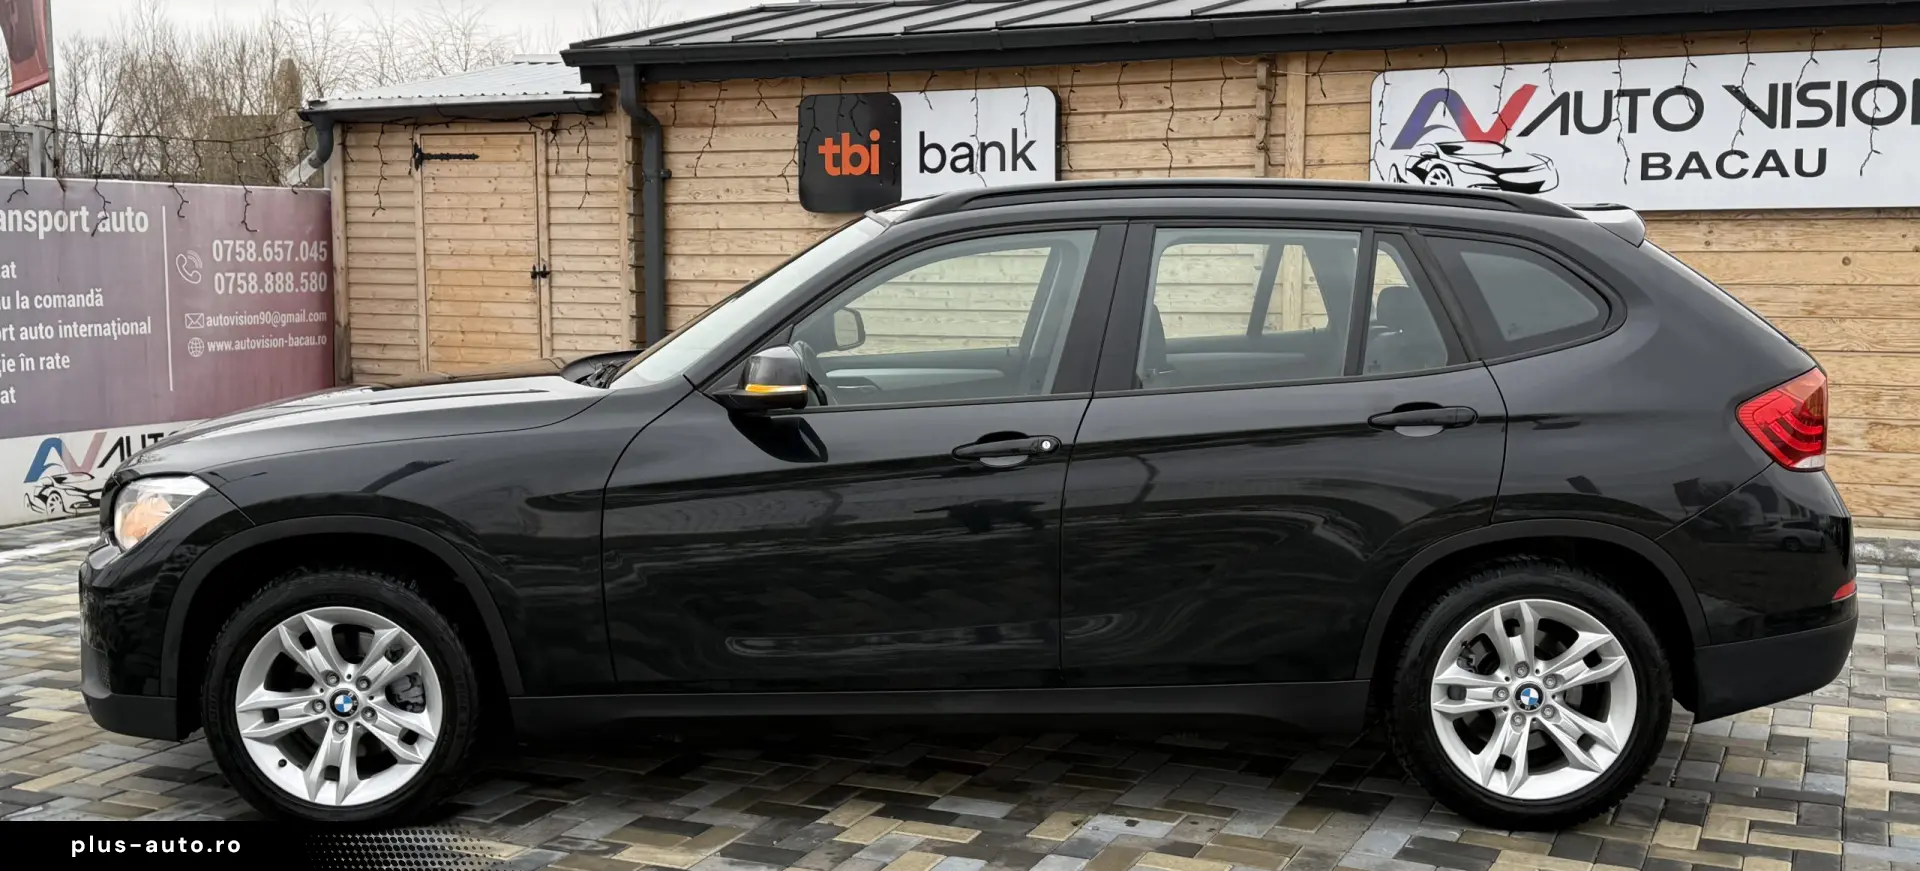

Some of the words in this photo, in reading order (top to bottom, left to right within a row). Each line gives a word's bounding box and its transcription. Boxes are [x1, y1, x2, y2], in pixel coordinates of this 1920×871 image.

[1517, 87, 1705, 137] AUTO
[1721, 78, 1920, 130] VISIO
[818, 129, 881, 177] tbi
[918, 127, 1037, 174] bank
[1640, 148, 1828, 181] BACAU
[97, 206, 149, 233] auto
[212, 239, 328, 262] 0758.657.045
[214, 271, 328, 295] 0758.888.580
[0, 295, 11, 310] u
[15, 290, 30, 309] la
[34, 287, 104, 309] comandă
[206, 309, 327, 327] autovision90@gmail.com
[0, 323, 16, 341] rt
[19, 322, 54, 340] auto
[207, 332, 327, 352] www.autovision-bacau.ro
[18, 353, 36, 372] în
[39, 352, 71, 370] rate
